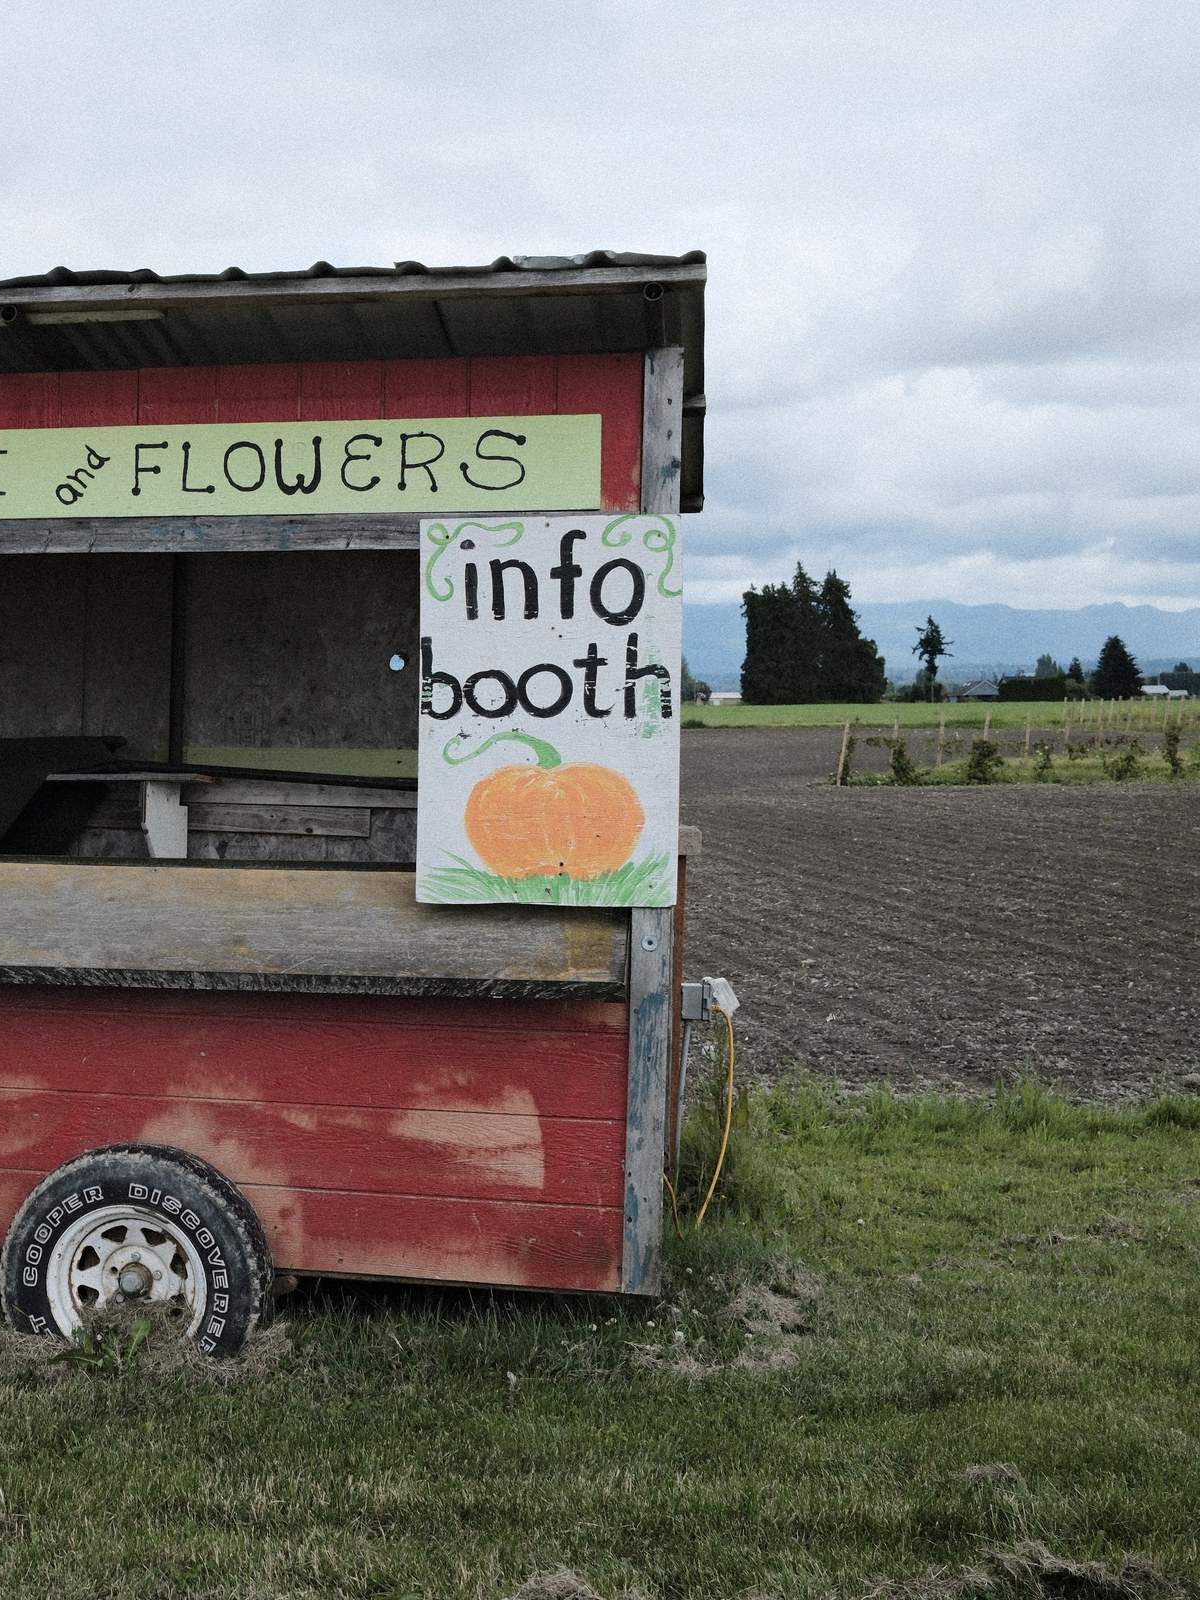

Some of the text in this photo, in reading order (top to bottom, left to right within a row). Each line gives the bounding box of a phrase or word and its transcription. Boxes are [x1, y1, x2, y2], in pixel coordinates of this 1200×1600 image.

[55, 444, 110, 505] and
[131, 429, 526, 495] FLOWERS
[460, 529, 645, 626] info
[420, 632, 673, 719] booth
[23, 1185, 104, 1287] COOPER
